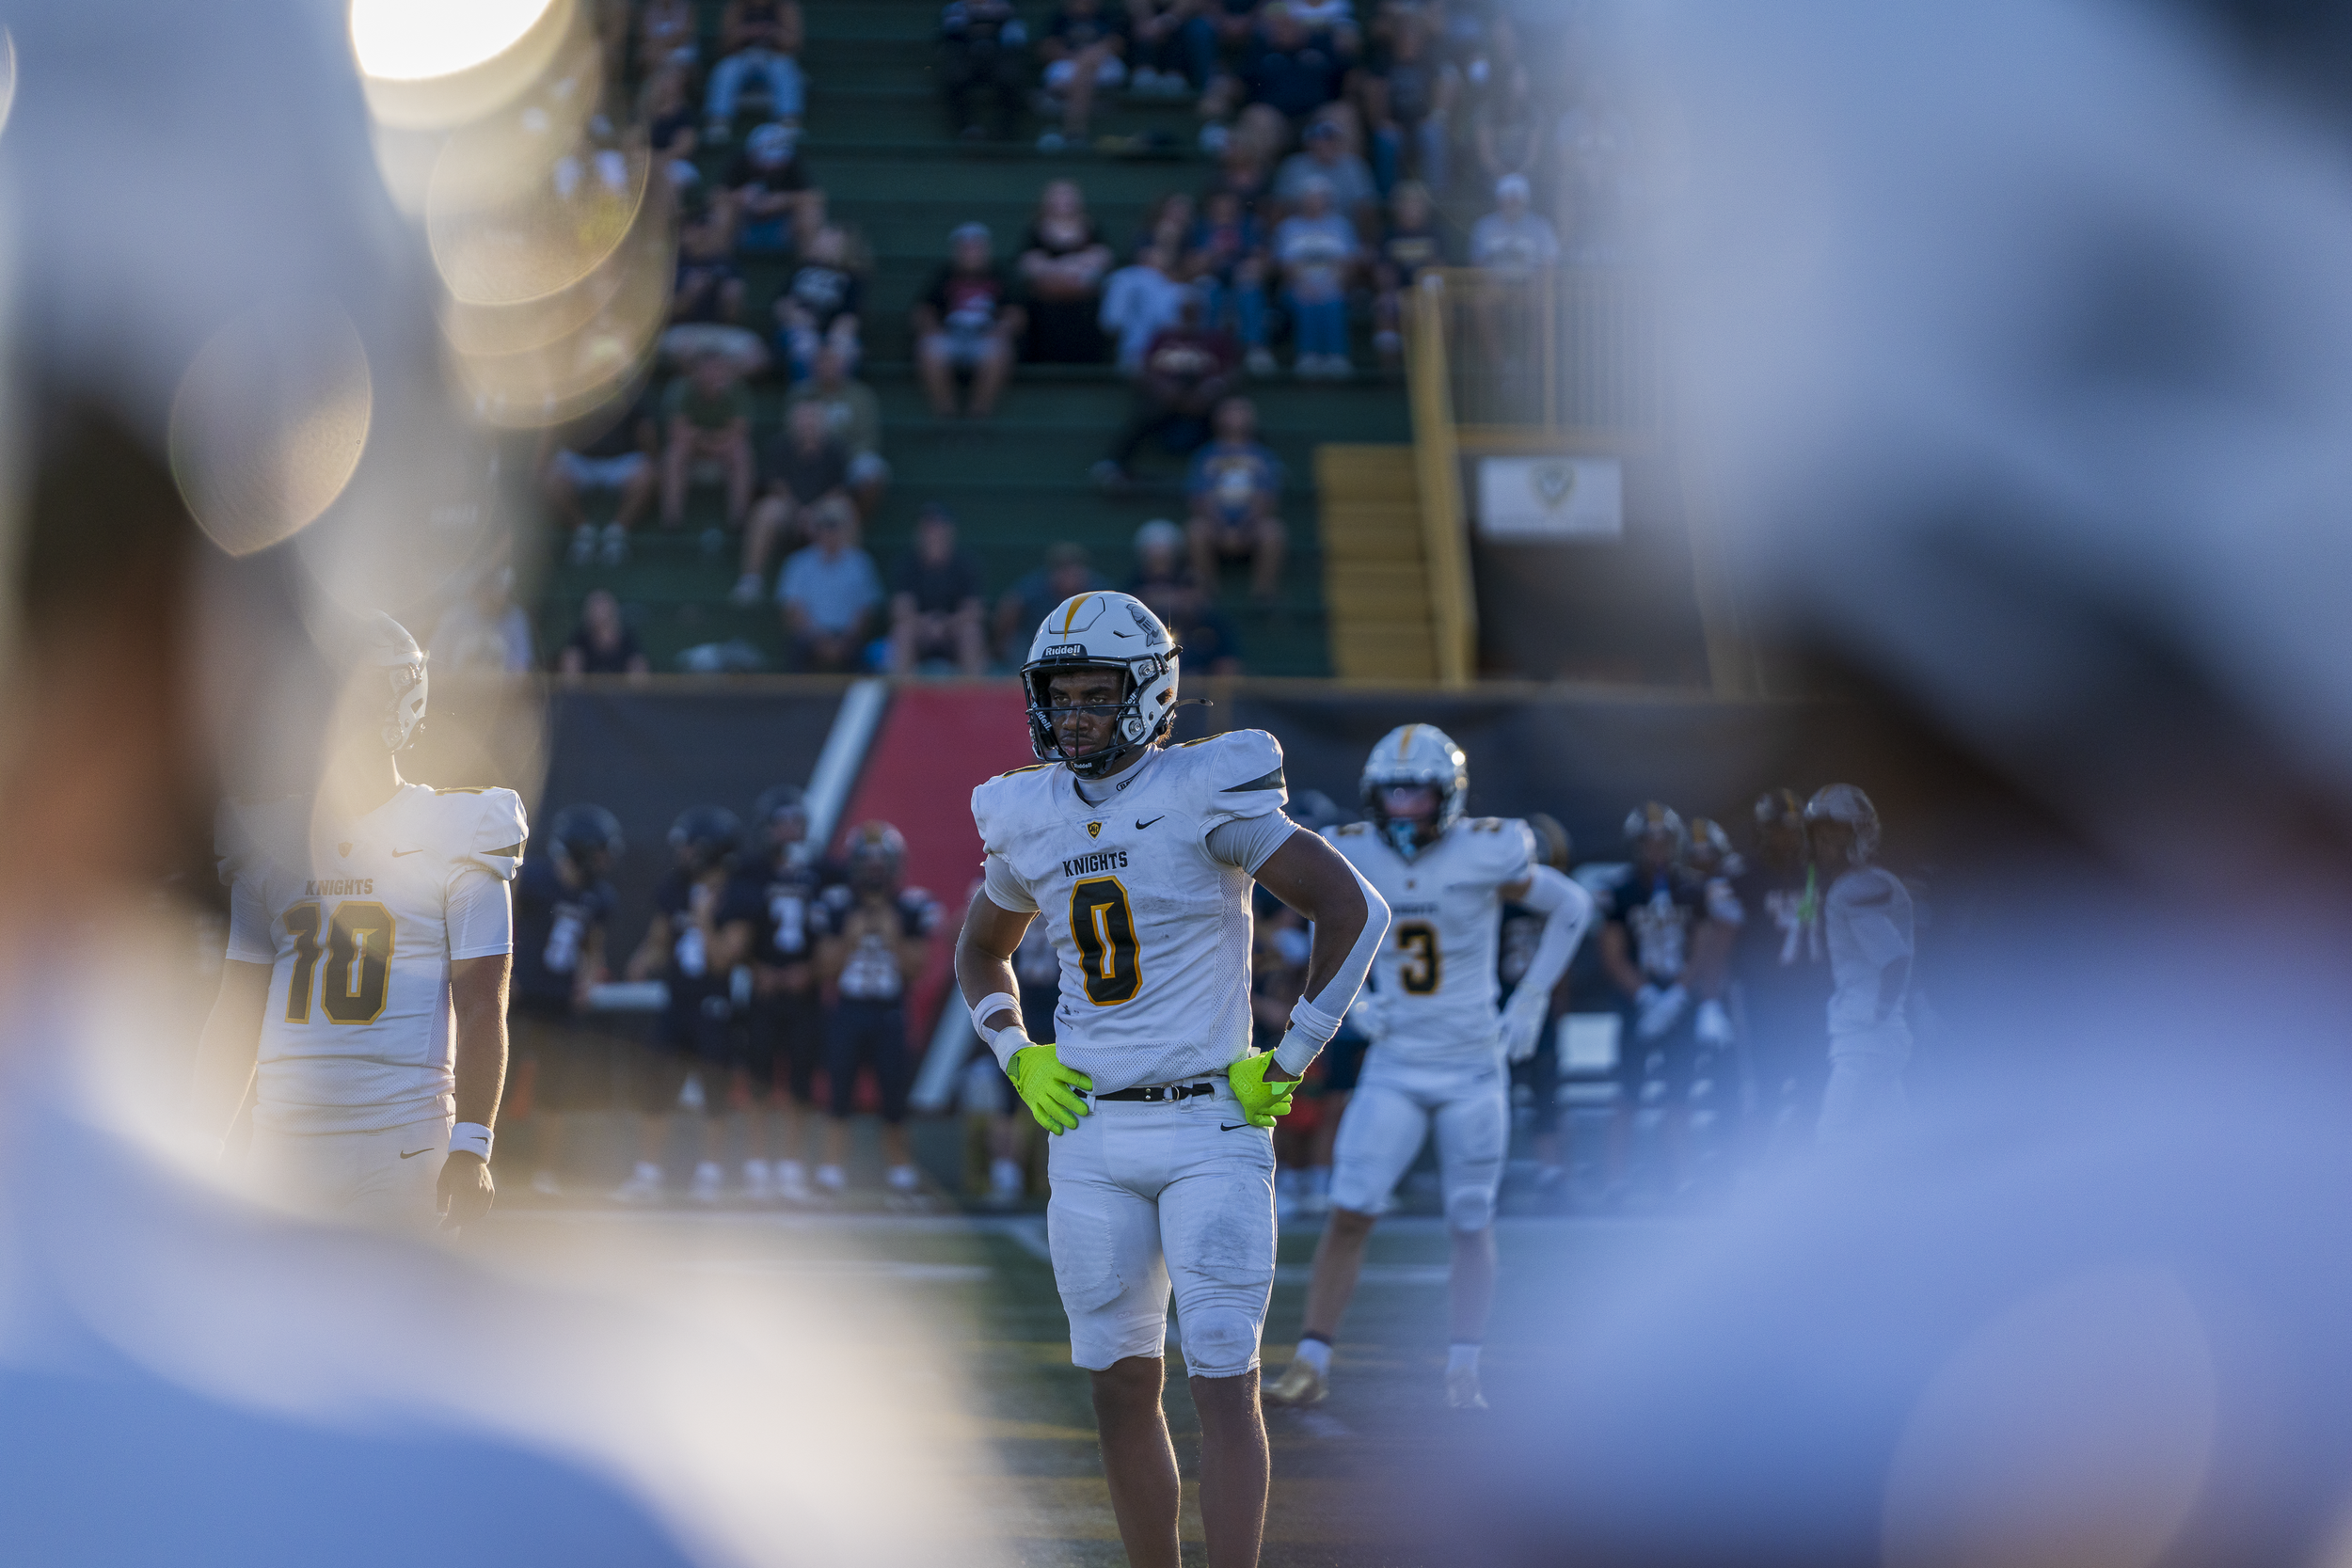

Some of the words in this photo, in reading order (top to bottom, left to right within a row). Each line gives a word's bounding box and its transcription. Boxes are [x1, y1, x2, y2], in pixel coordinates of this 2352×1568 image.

[1045, 644, 1081, 656] Riddell
[1031, 701, 1053, 731] Rddell
[1062, 851, 1128, 878] KNIGHTS
[305, 878, 373, 895] KNIGHTS
[1069, 875, 1143, 1006] 0
[282, 900, 396, 1025] 10
[1394, 919, 1440, 995] 3
